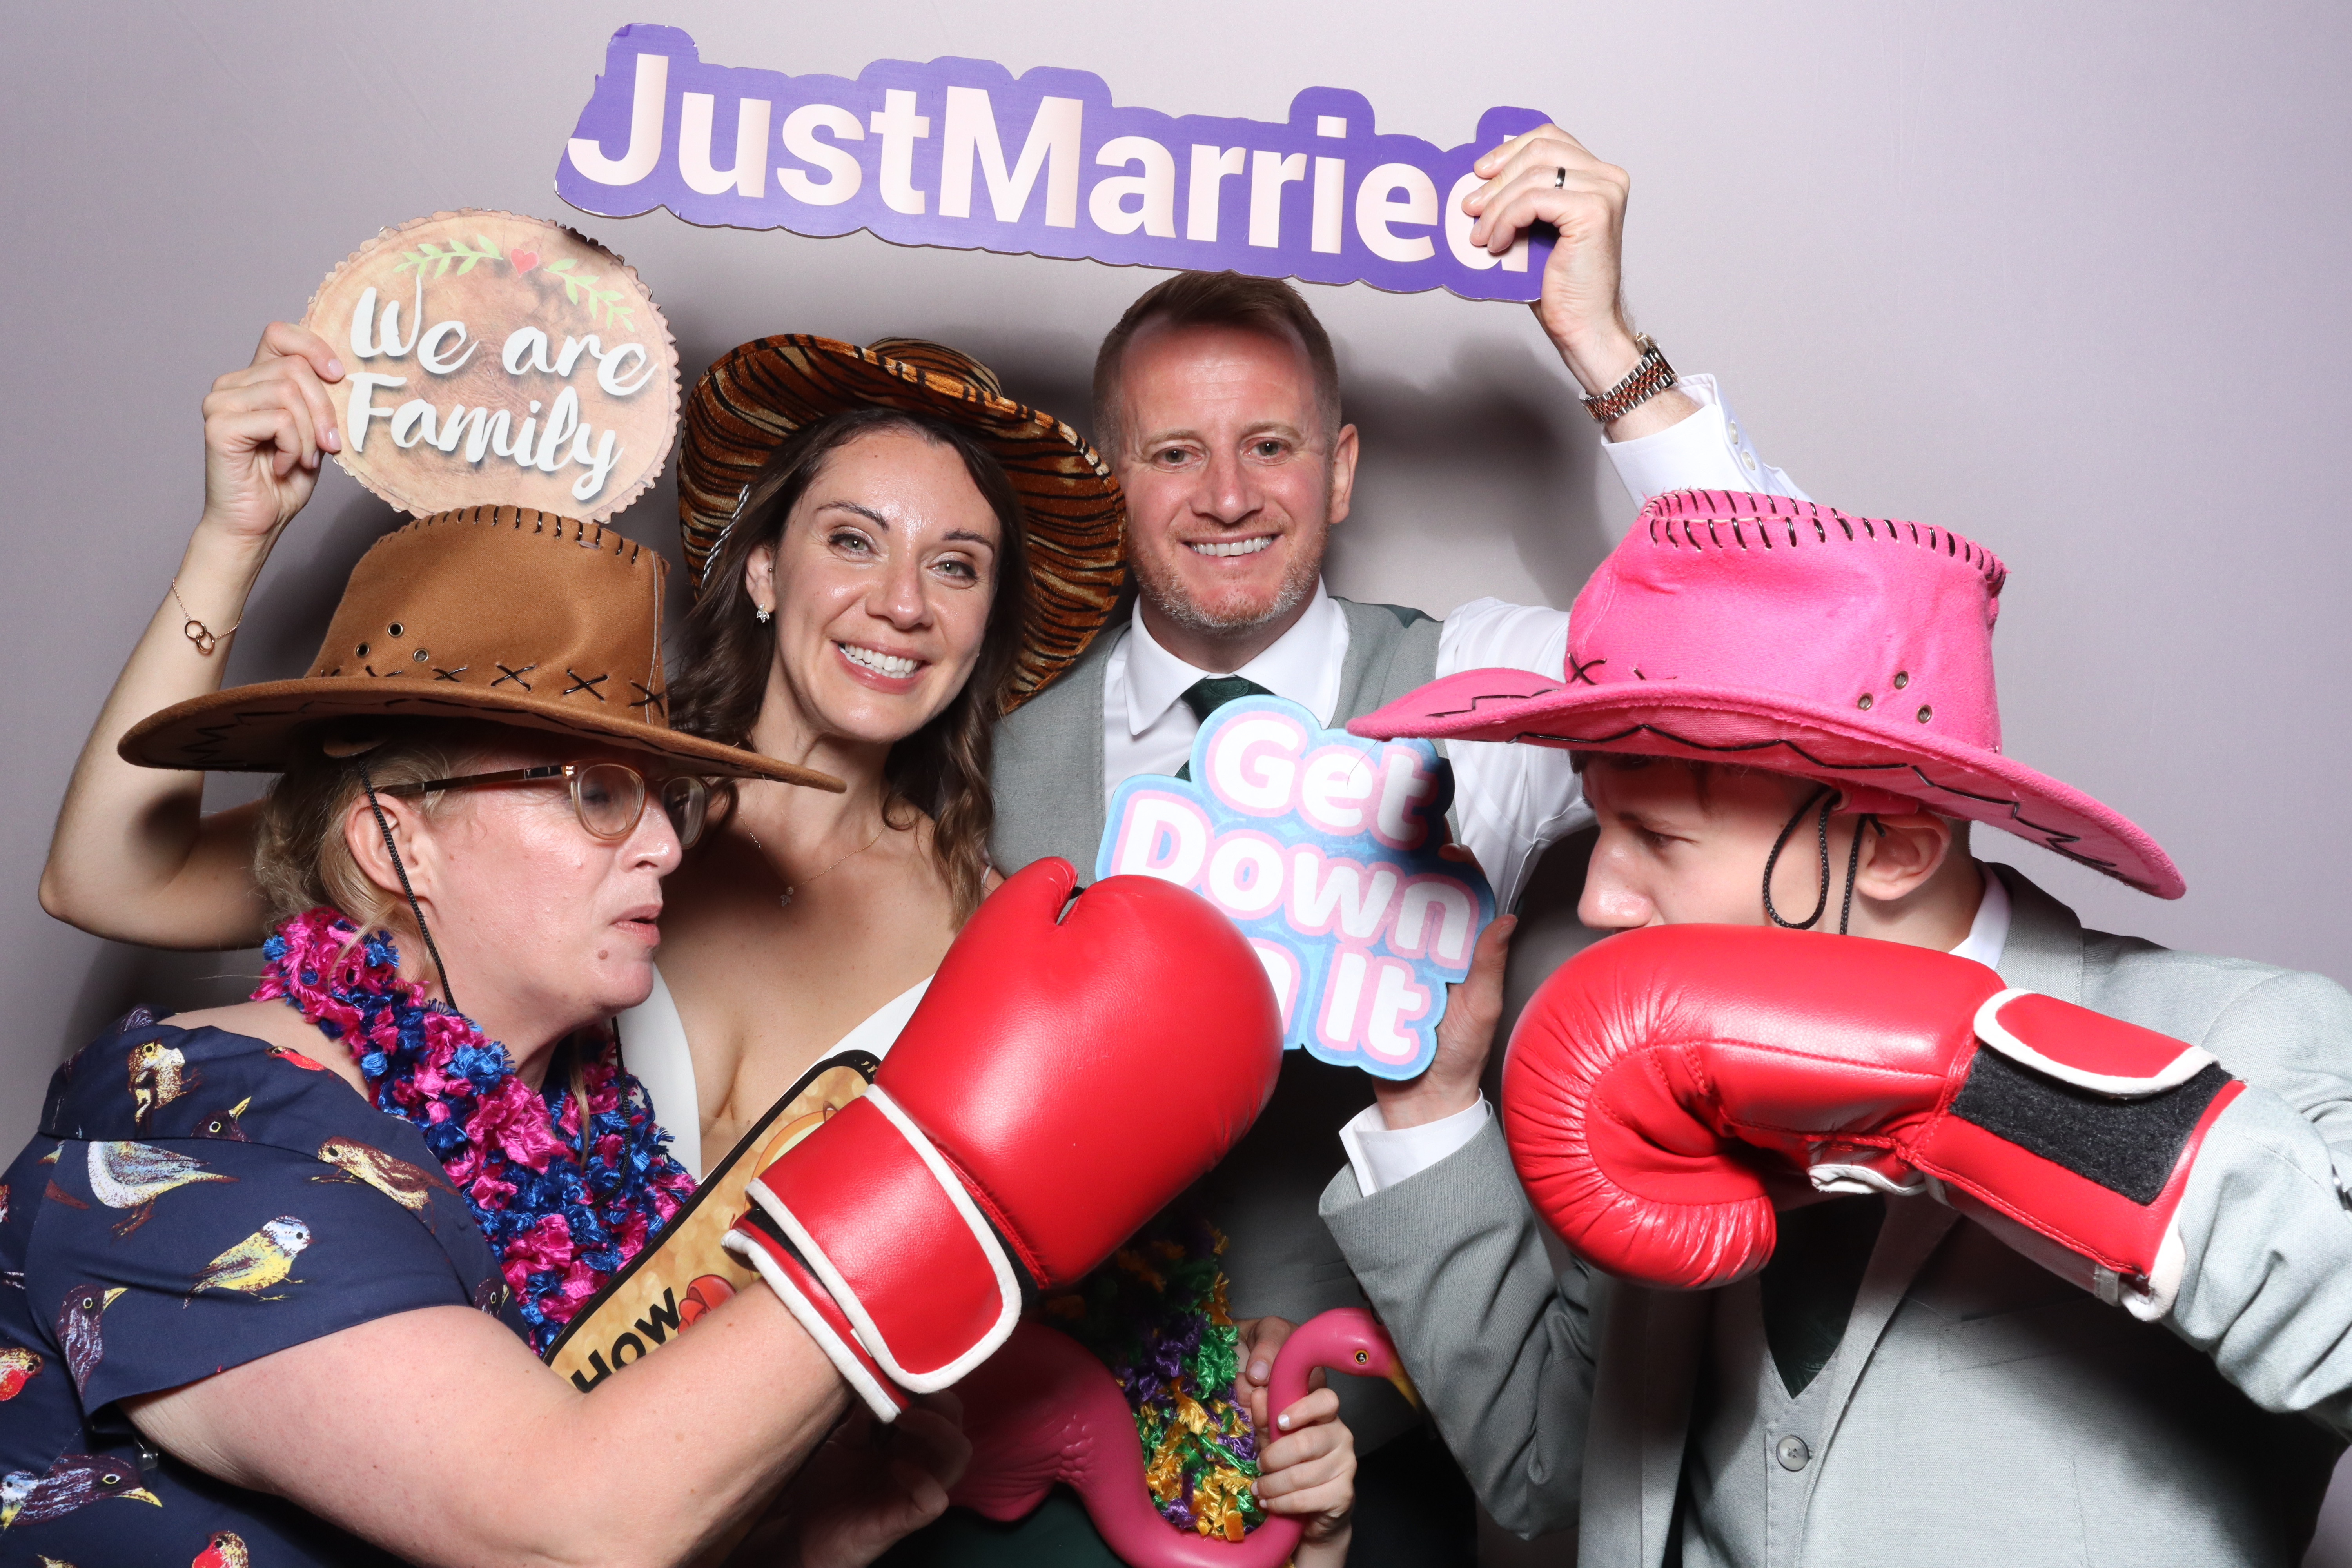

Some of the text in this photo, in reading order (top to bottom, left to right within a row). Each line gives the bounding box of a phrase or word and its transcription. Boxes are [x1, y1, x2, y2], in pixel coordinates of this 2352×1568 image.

[349, 273, 658, 396] We are
[345, 371, 624, 501] Family
[1211, 717, 1429, 843] Get
[1116, 795, 1474, 963] Down
[1323, 950, 1424, 1058] It
